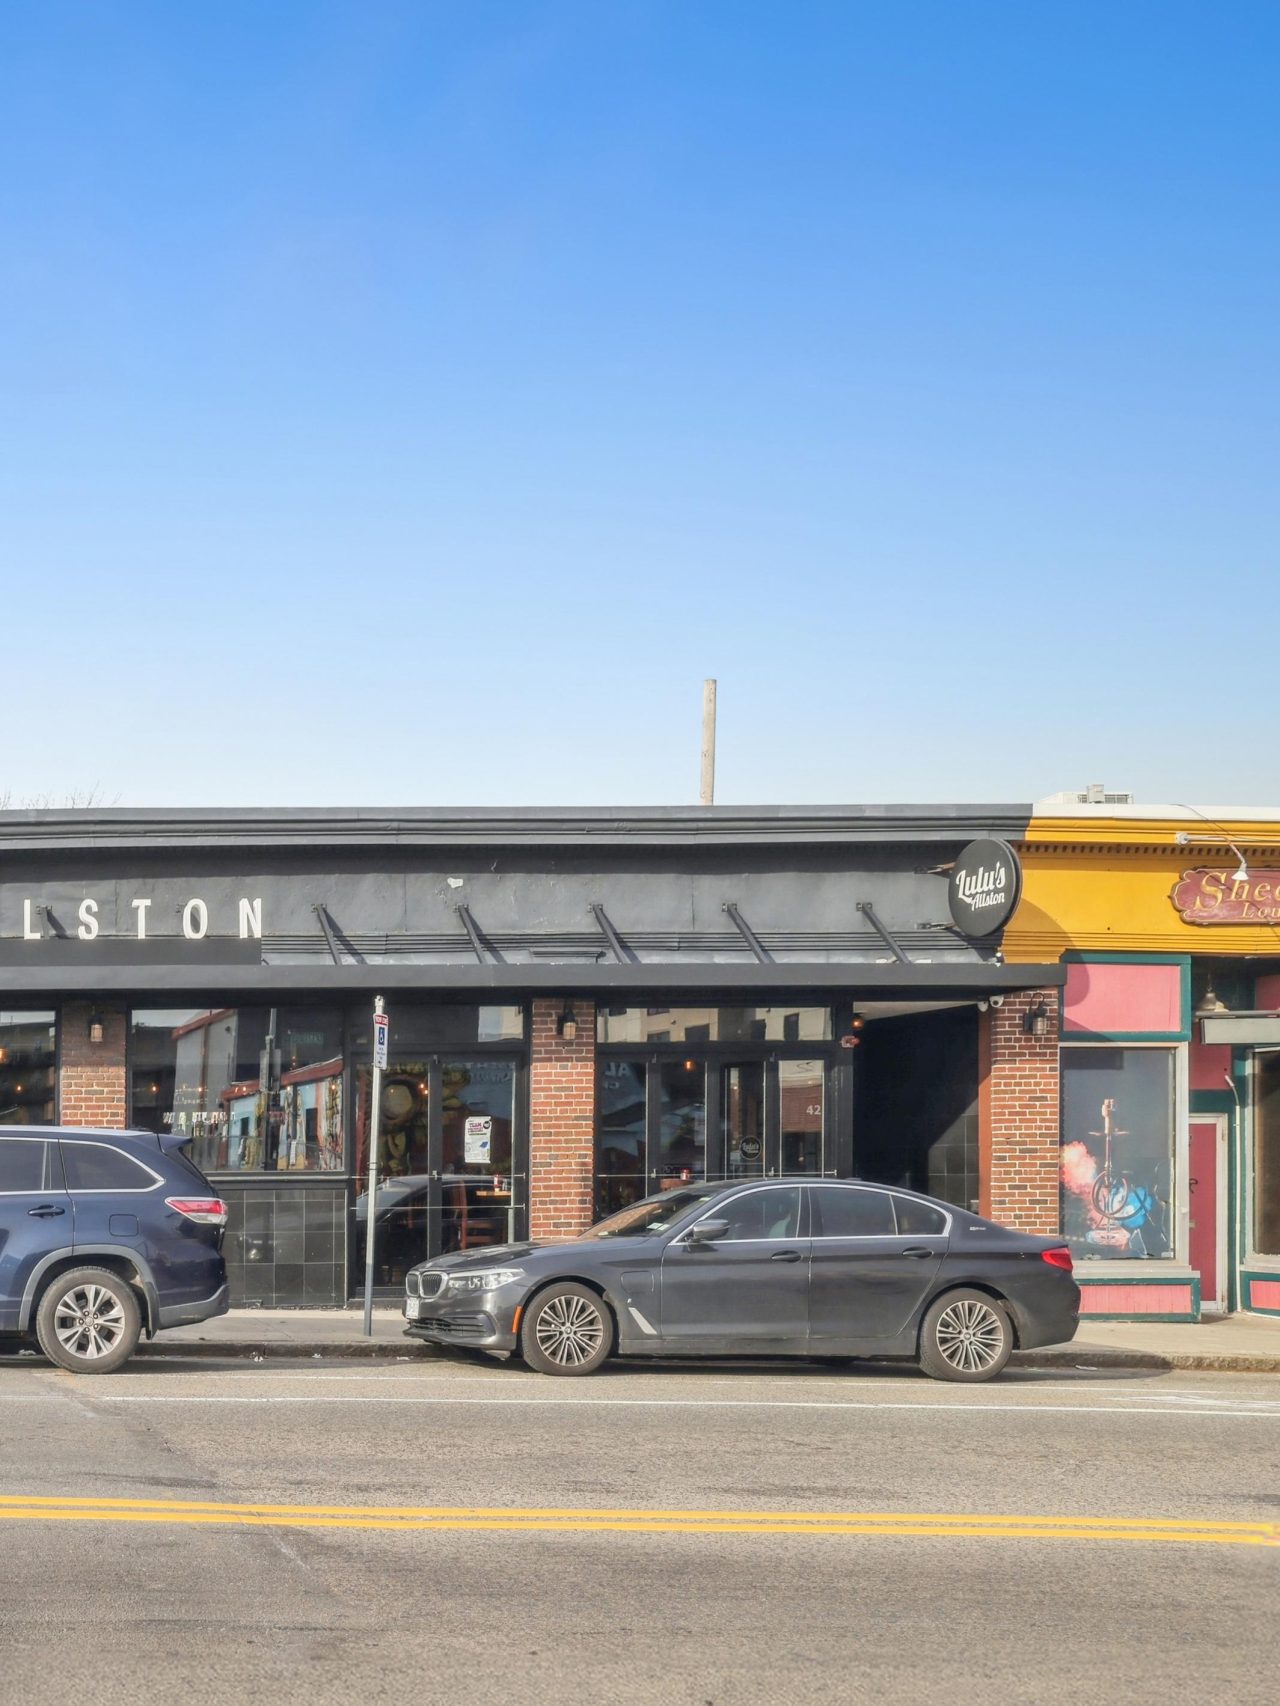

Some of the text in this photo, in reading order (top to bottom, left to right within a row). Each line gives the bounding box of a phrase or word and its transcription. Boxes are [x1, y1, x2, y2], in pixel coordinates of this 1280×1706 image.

[955, 860, 1006, 904] Lulu's
[970, 891, 1005, 912] Allston
[806, 1104, 822, 1116] 42
